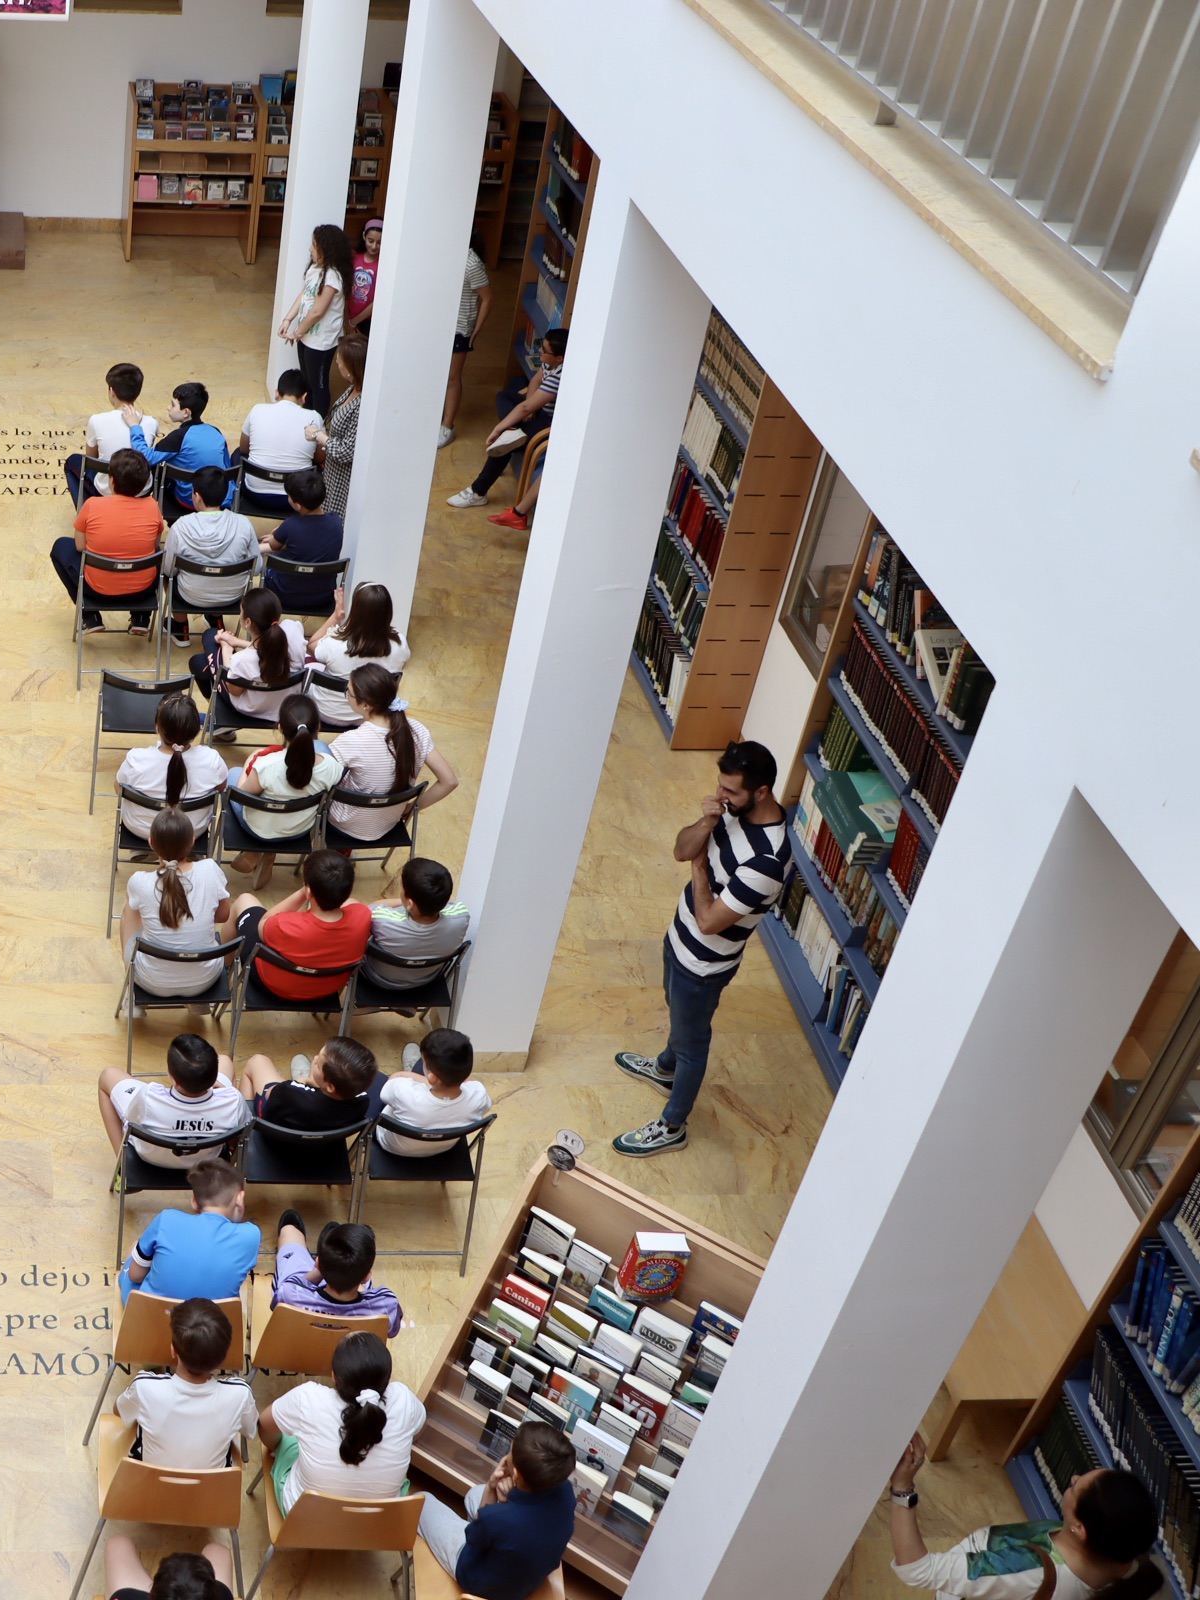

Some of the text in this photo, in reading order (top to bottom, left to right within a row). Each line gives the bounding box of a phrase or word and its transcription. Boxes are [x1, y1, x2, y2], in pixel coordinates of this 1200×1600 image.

[16, 427, 32, 436] lo
[42, 429, 75, 441] que
[5, 443, 16, 452] y
[22, 441, 68, 451] estás
[172, 1117, 215, 1132] JESÚS
[646, 1259, 680, 1269] MUNDO
[20, 1264, 91, 1294] dejo
[504, 1286, 542, 1312] Canina
[640, 1326, 677, 1352] RUIDO
[622, 1393, 658, 1430] YO
